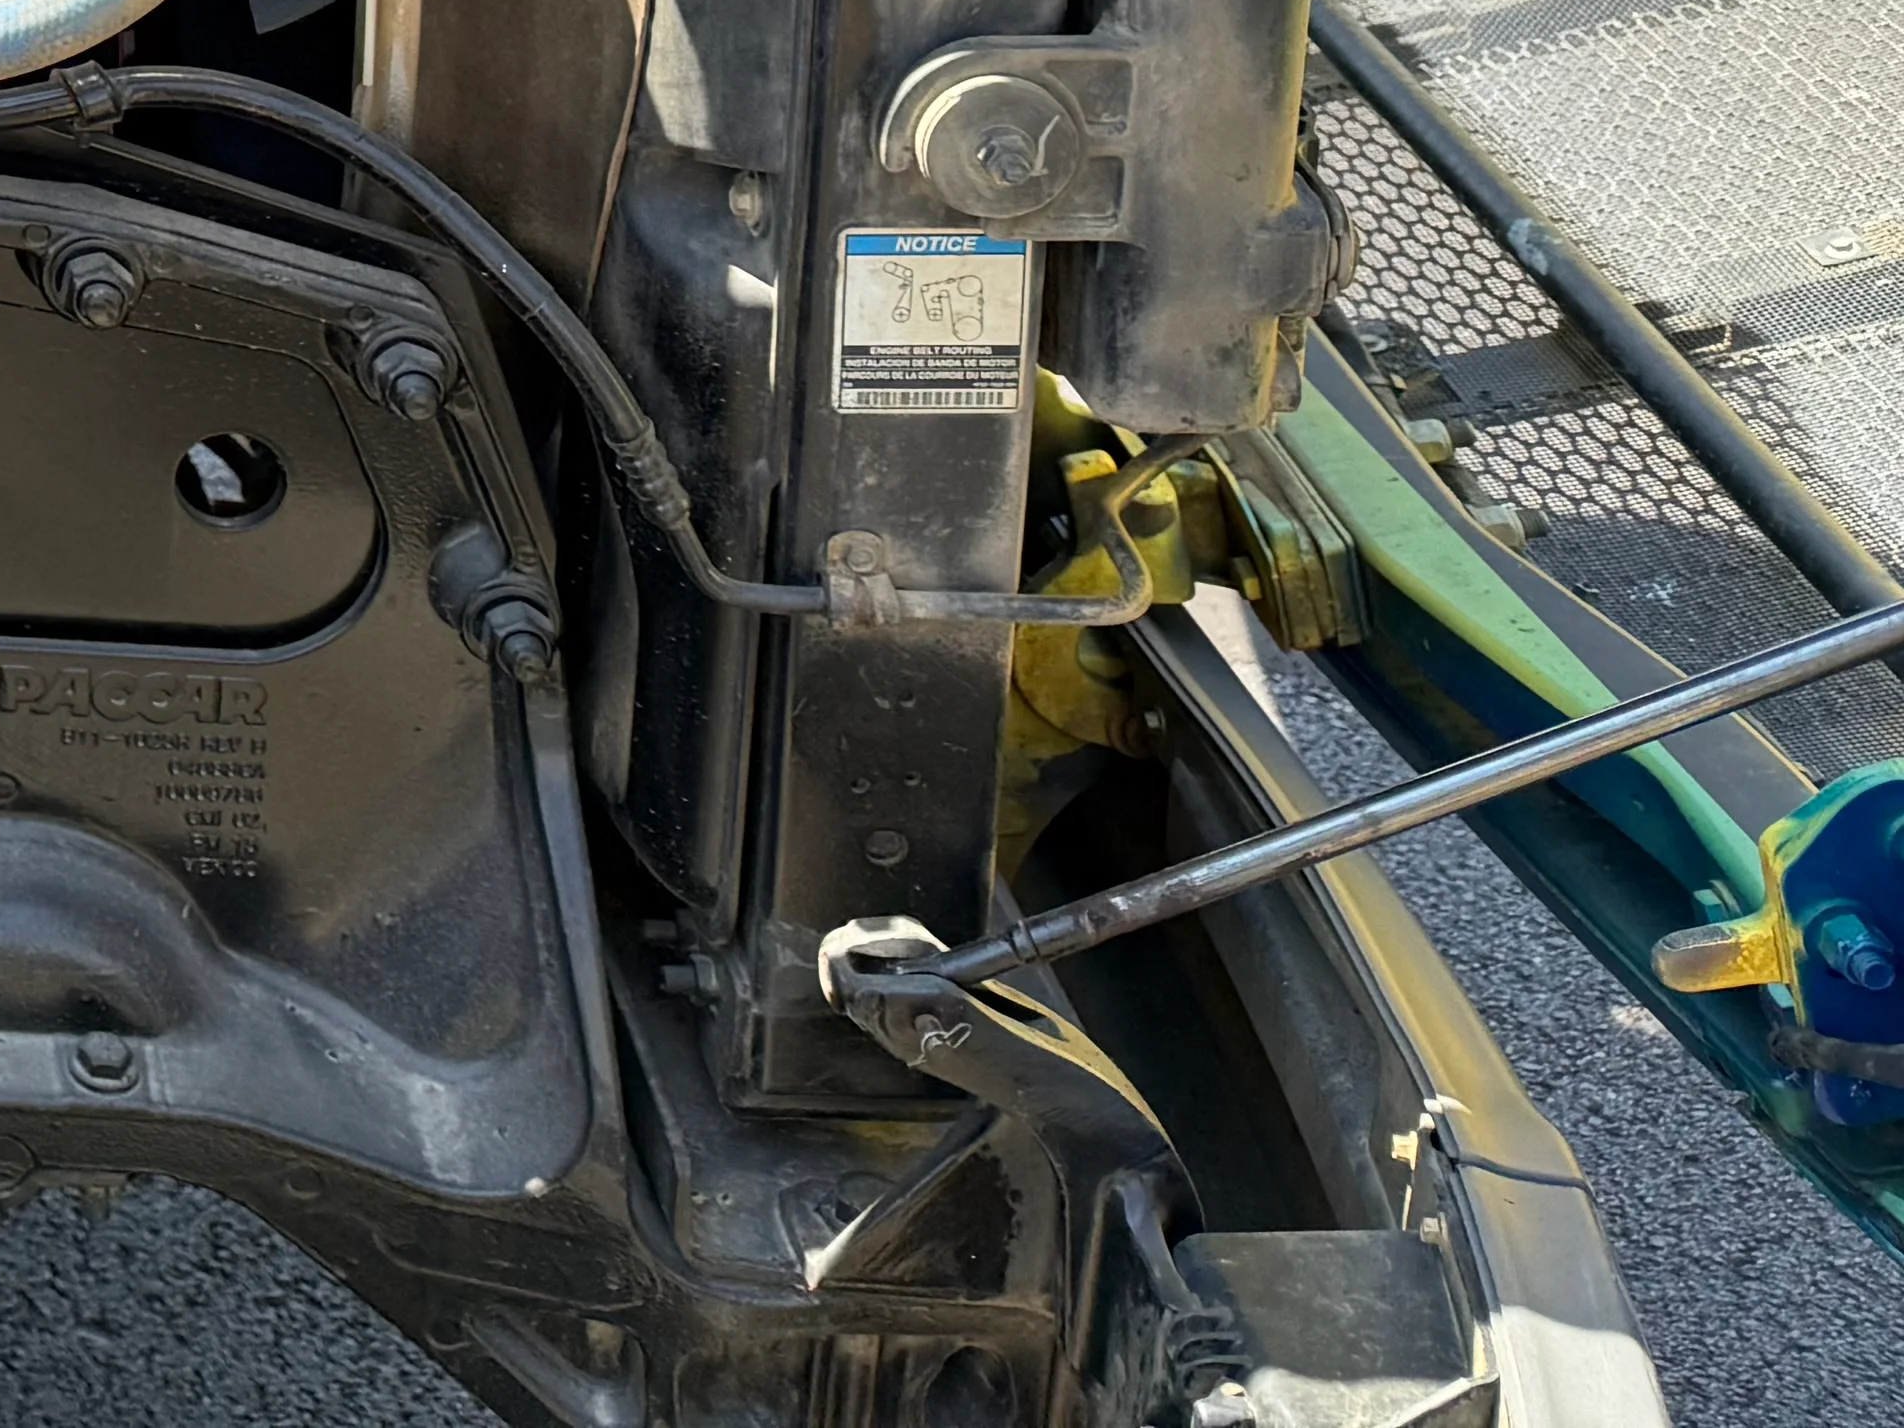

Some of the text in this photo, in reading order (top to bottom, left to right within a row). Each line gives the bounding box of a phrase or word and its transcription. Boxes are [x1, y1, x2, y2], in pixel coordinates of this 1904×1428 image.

[896, 236, 978, 251] NOTICE
[913, 347, 940, 355] BELT
[943, 347, 992, 355] ROUTING
